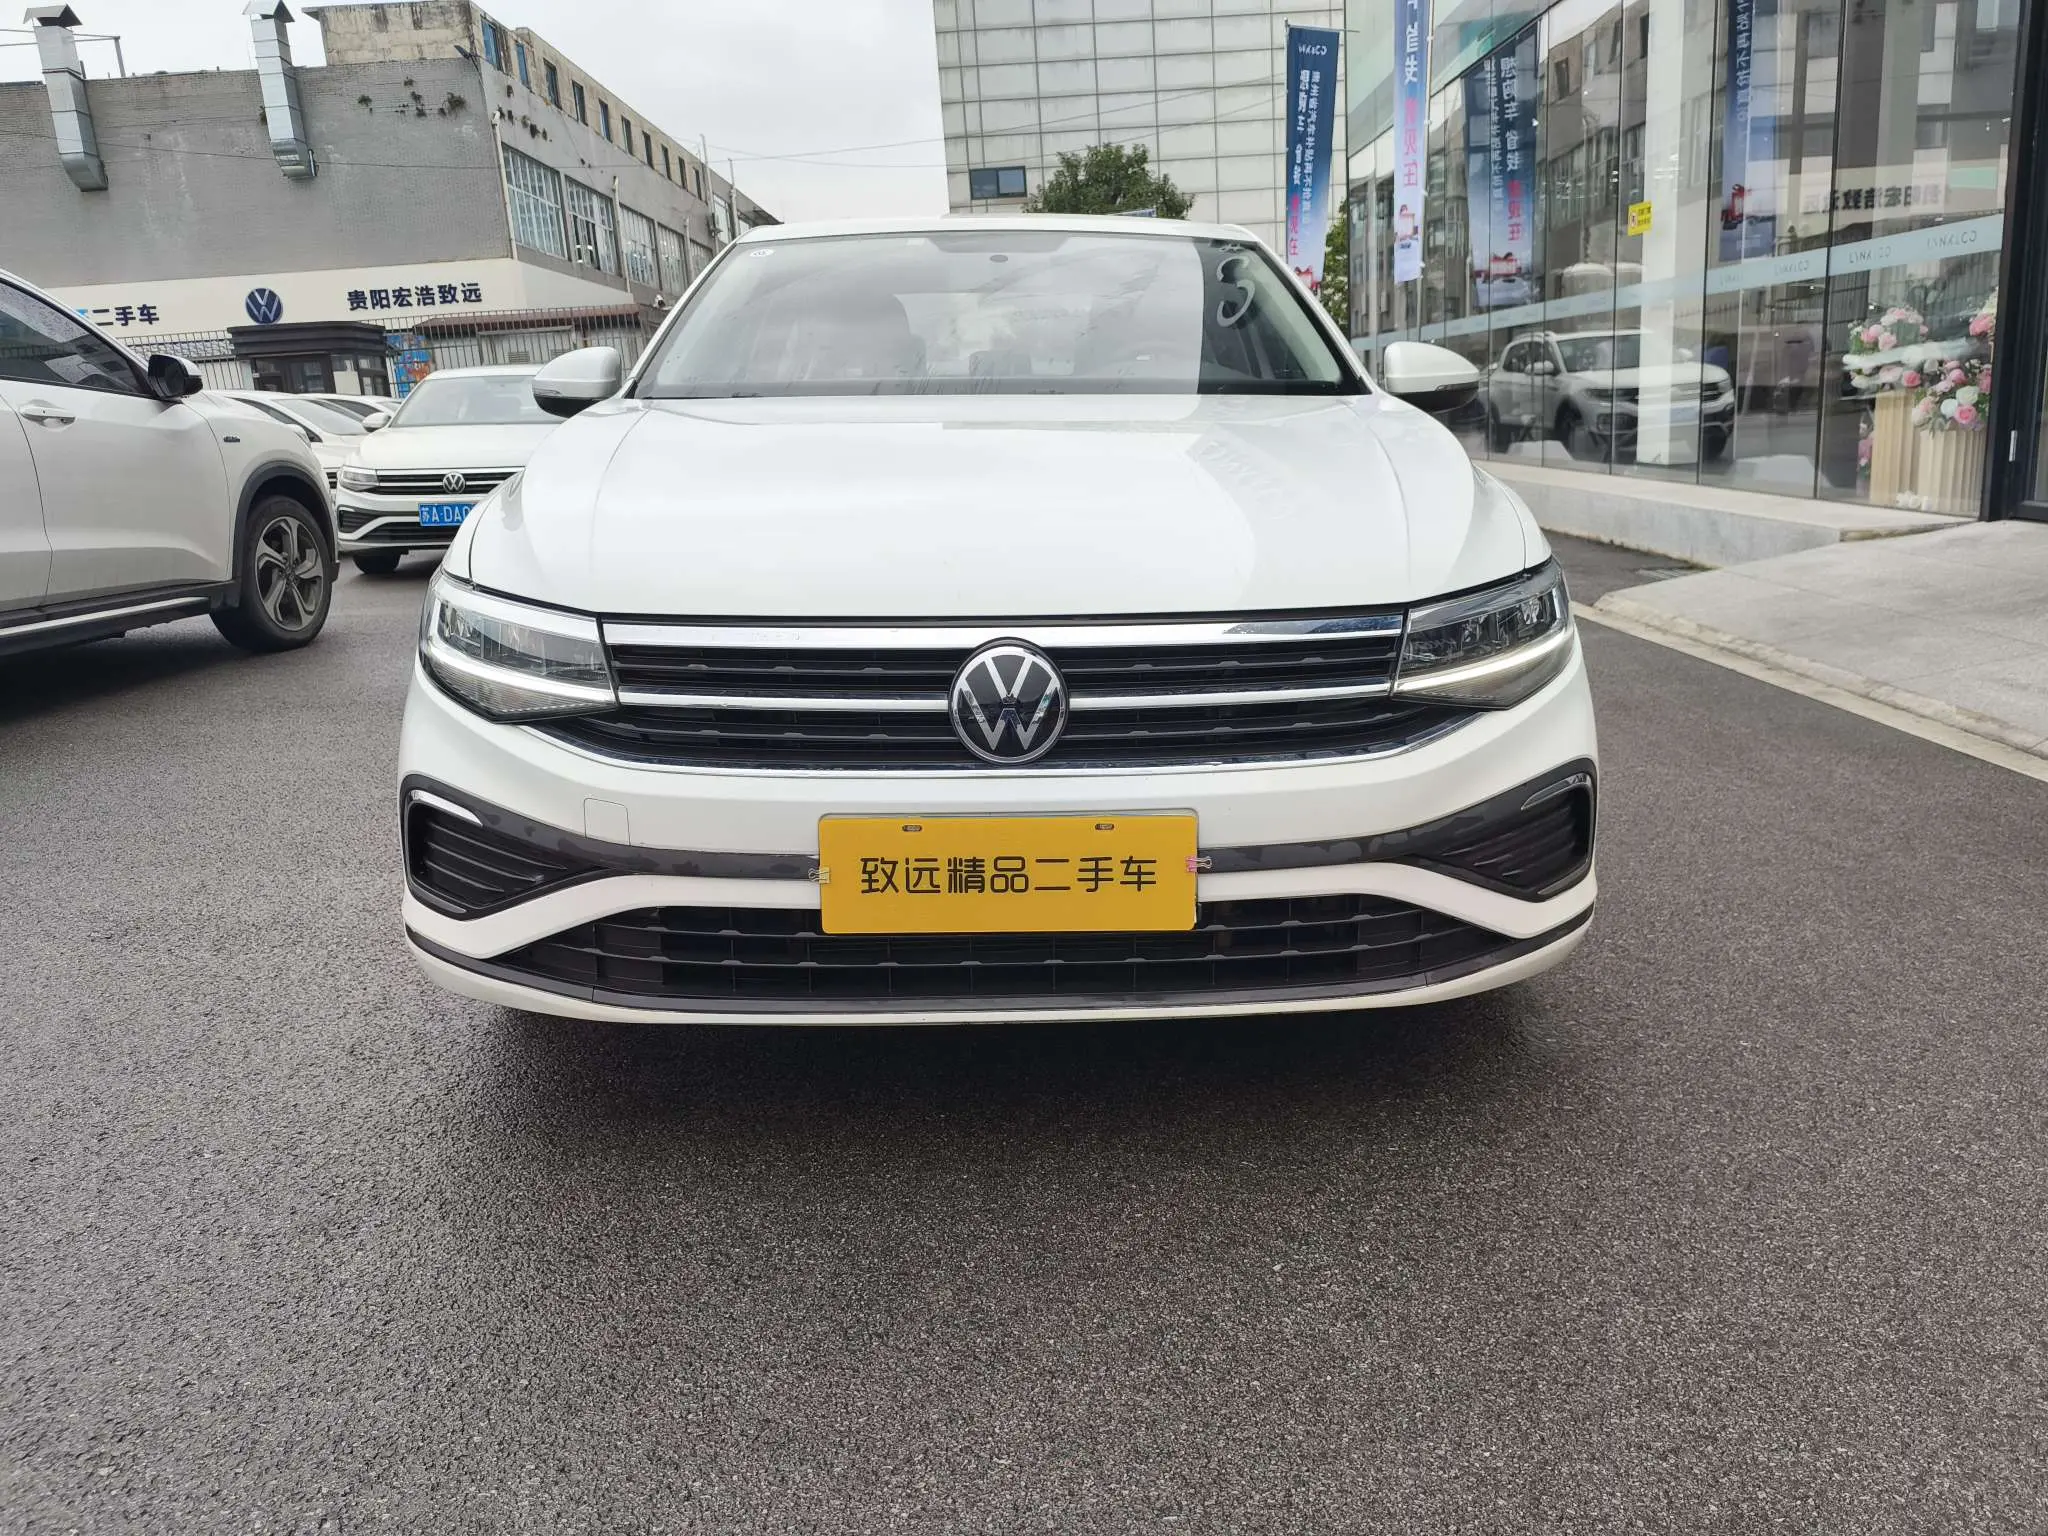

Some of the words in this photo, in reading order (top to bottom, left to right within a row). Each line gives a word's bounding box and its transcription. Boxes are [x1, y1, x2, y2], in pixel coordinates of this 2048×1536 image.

[347, 282, 483, 311] 贵阳宏浩致远
[860, 855, 1158, 894] 致远精品二手车
